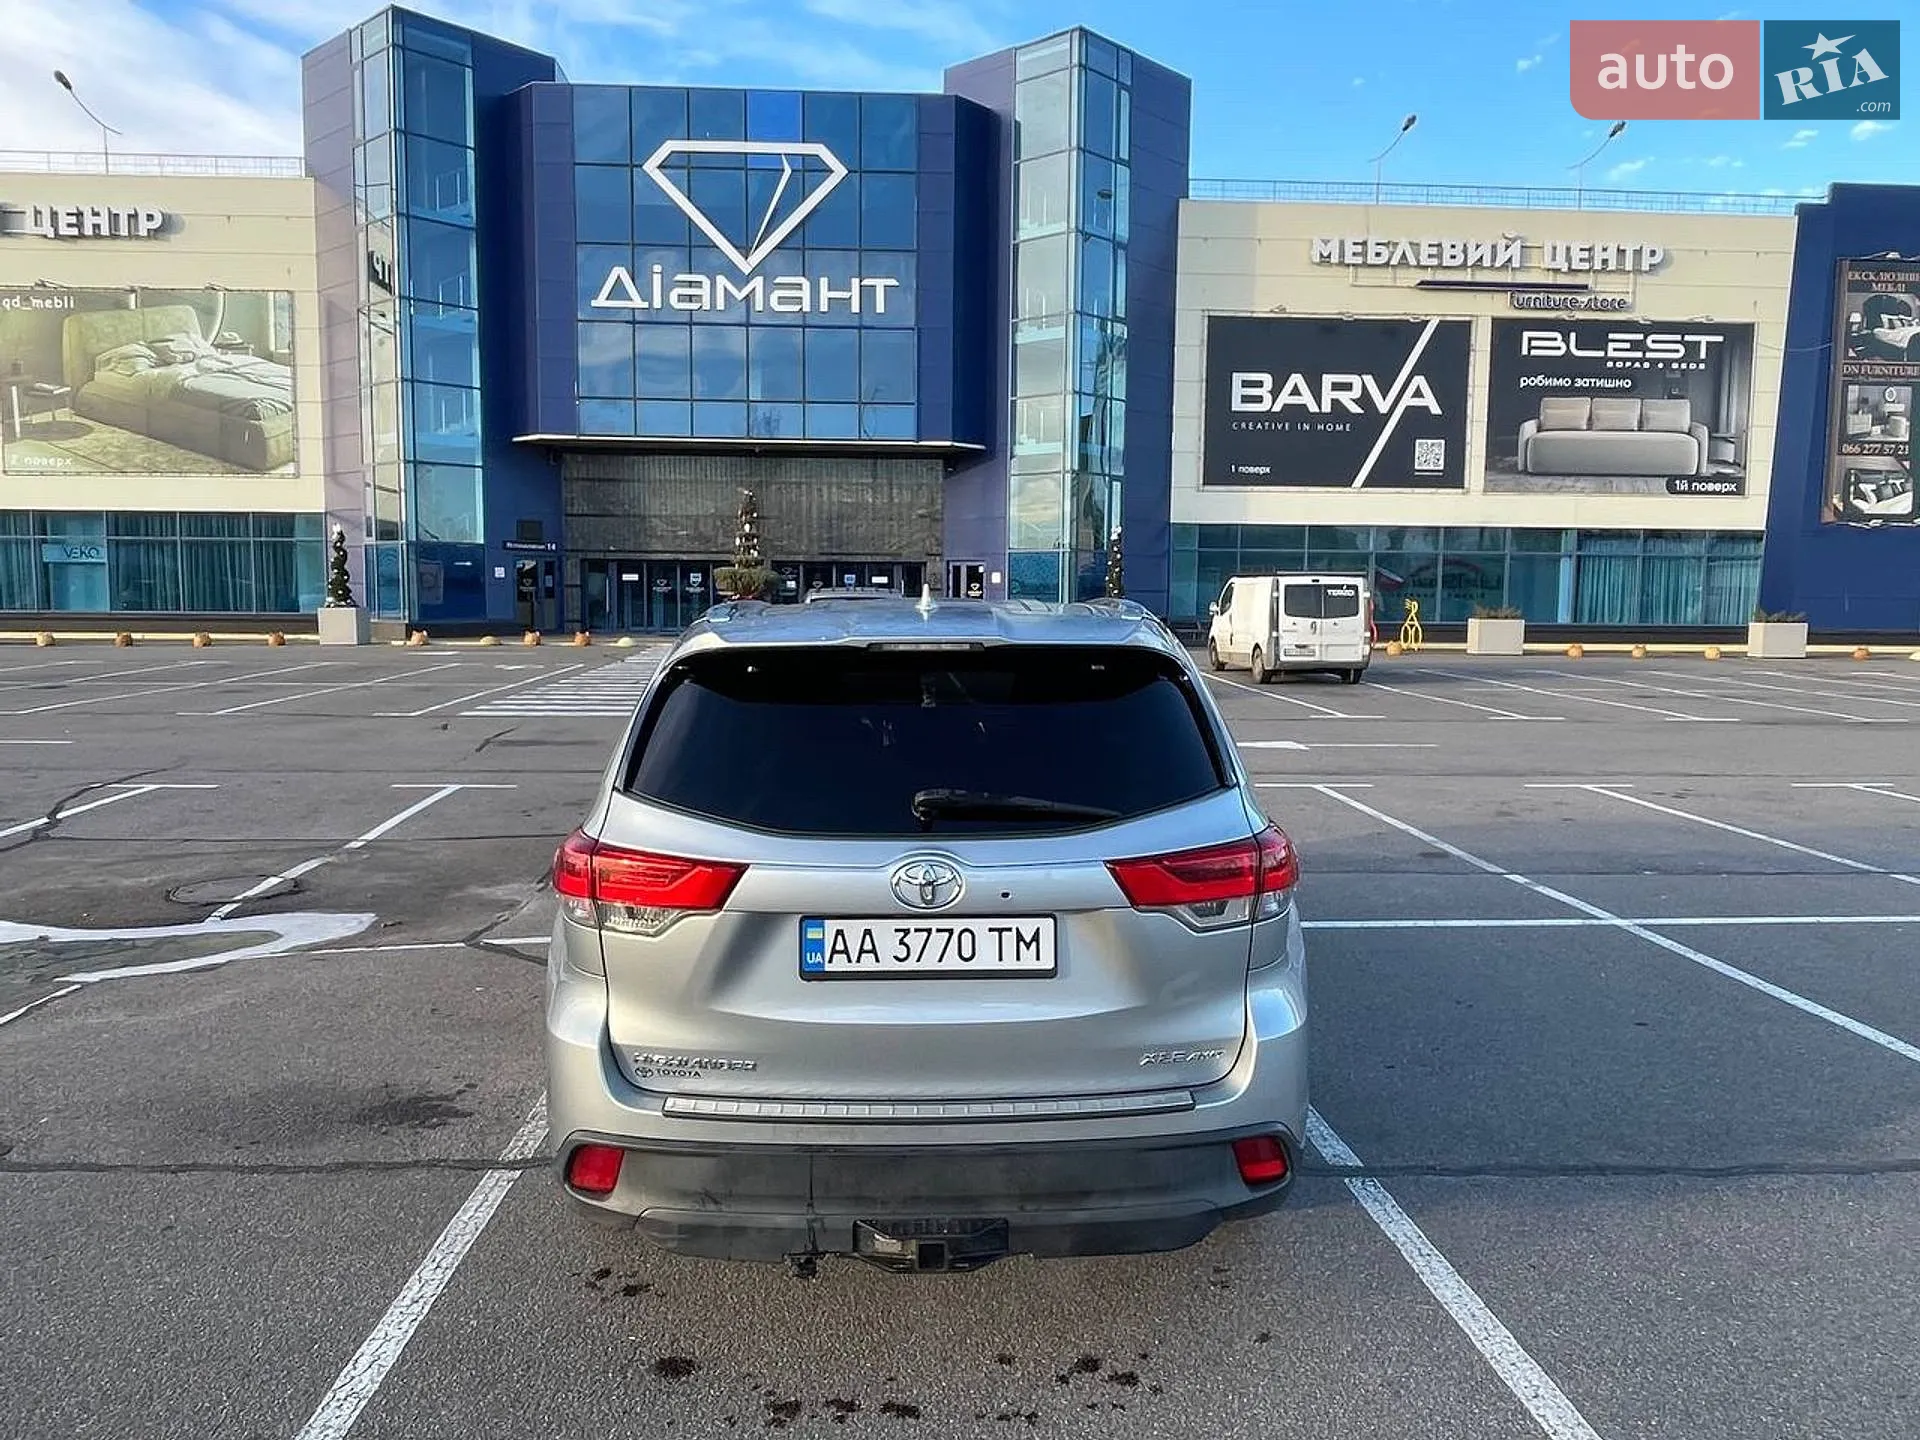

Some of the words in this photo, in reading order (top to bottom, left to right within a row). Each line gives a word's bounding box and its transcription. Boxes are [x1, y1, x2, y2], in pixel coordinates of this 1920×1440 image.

[26, 203, 163, 239] ЦЕНТР
[1312, 230, 1523, 268] МЕБЛЕВИЙ
[1542, 240, 1667, 272] ЦЕНТР
[1522, 331, 1724, 360] BLEST
[1231, 372, 1443, 415] BARVA
[1519, 374, 1571, 388] робимо
[1574, 376, 1632, 389] затишно
[1232, 422, 1290, 431] CREATIVE
[1298, 423, 1310, 431] IN
[1316, 423, 1351, 432] HOME
[1691, 482, 1737, 493] поверх
[807, 952, 824, 964] UA
[828, 928, 880, 964] AA
[893, 928, 976, 963] 3770
[988, 927, 1041, 962] TM
[633, 1051, 757, 1071] HIGHLANDER
[656, 1069, 702, 1078] TOYOTA
